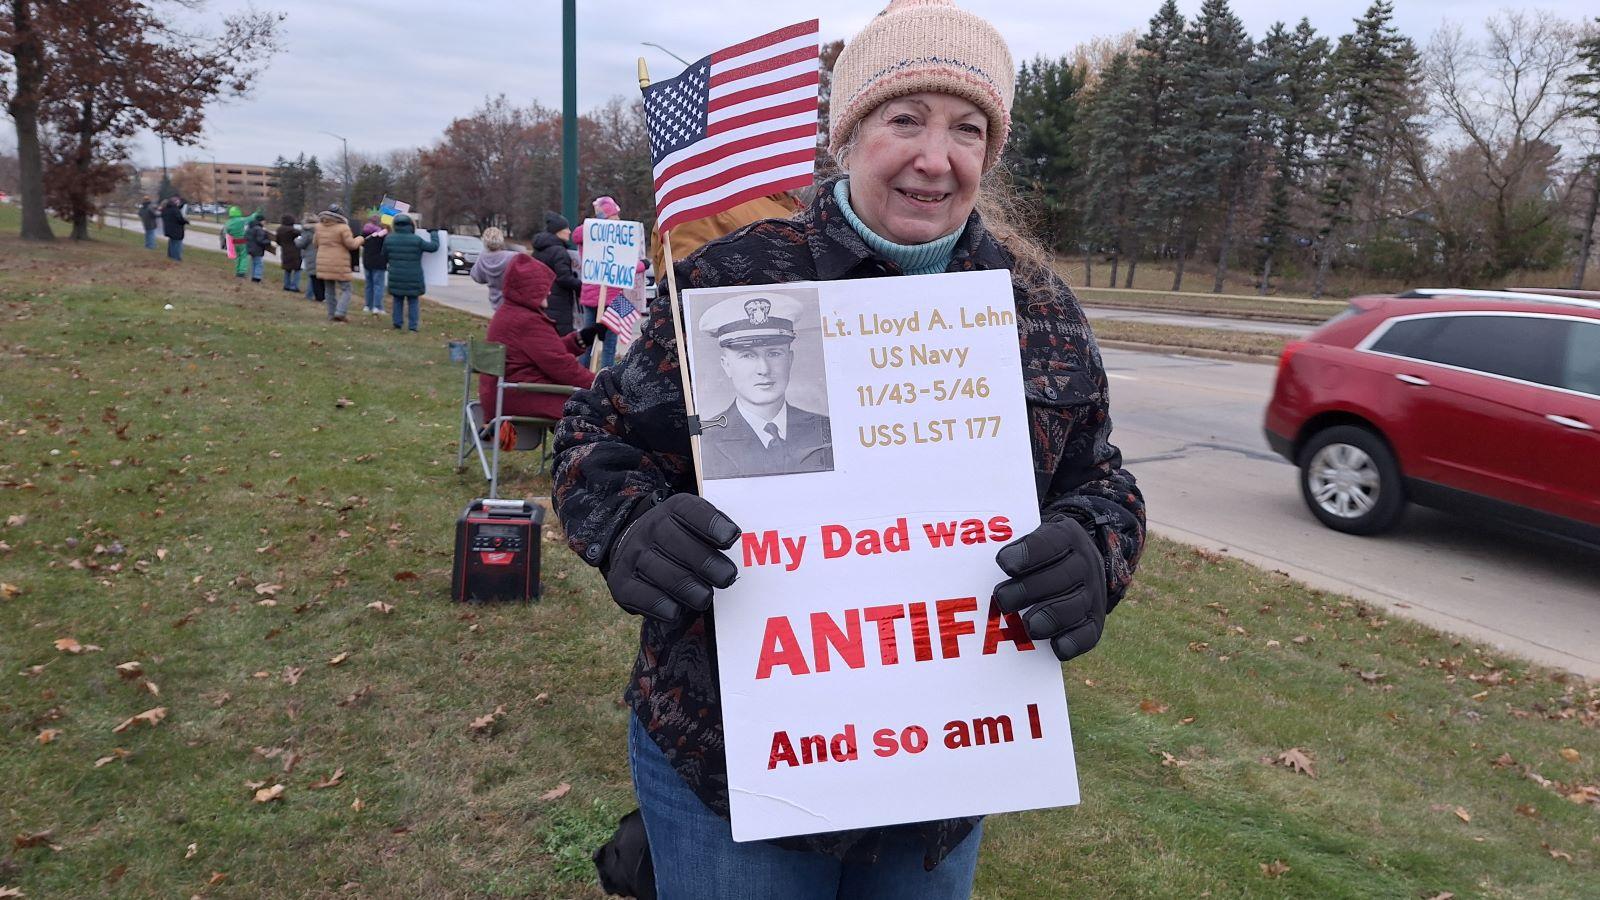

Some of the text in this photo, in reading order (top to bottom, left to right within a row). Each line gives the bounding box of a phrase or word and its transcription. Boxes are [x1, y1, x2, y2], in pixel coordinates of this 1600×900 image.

[590, 223, 634, 247] COURAGE
[602, 245, 615, 263] IS
[583, 259, 635, 286] CONTAGIOUS
[822, 306, 1014, 337] Lt. Lloyd A. Lehn
[870, 344, 969, 368] US Navy
[857, 377, 990, 406] 11/43-5/46
[859, 416, 1001, 447] USS LST 177
[741, 516, 1013, 571] My Dad was
[755, 595, 1036, 679] ANTIFA
[767, 703, 1043, 770] And so am I
